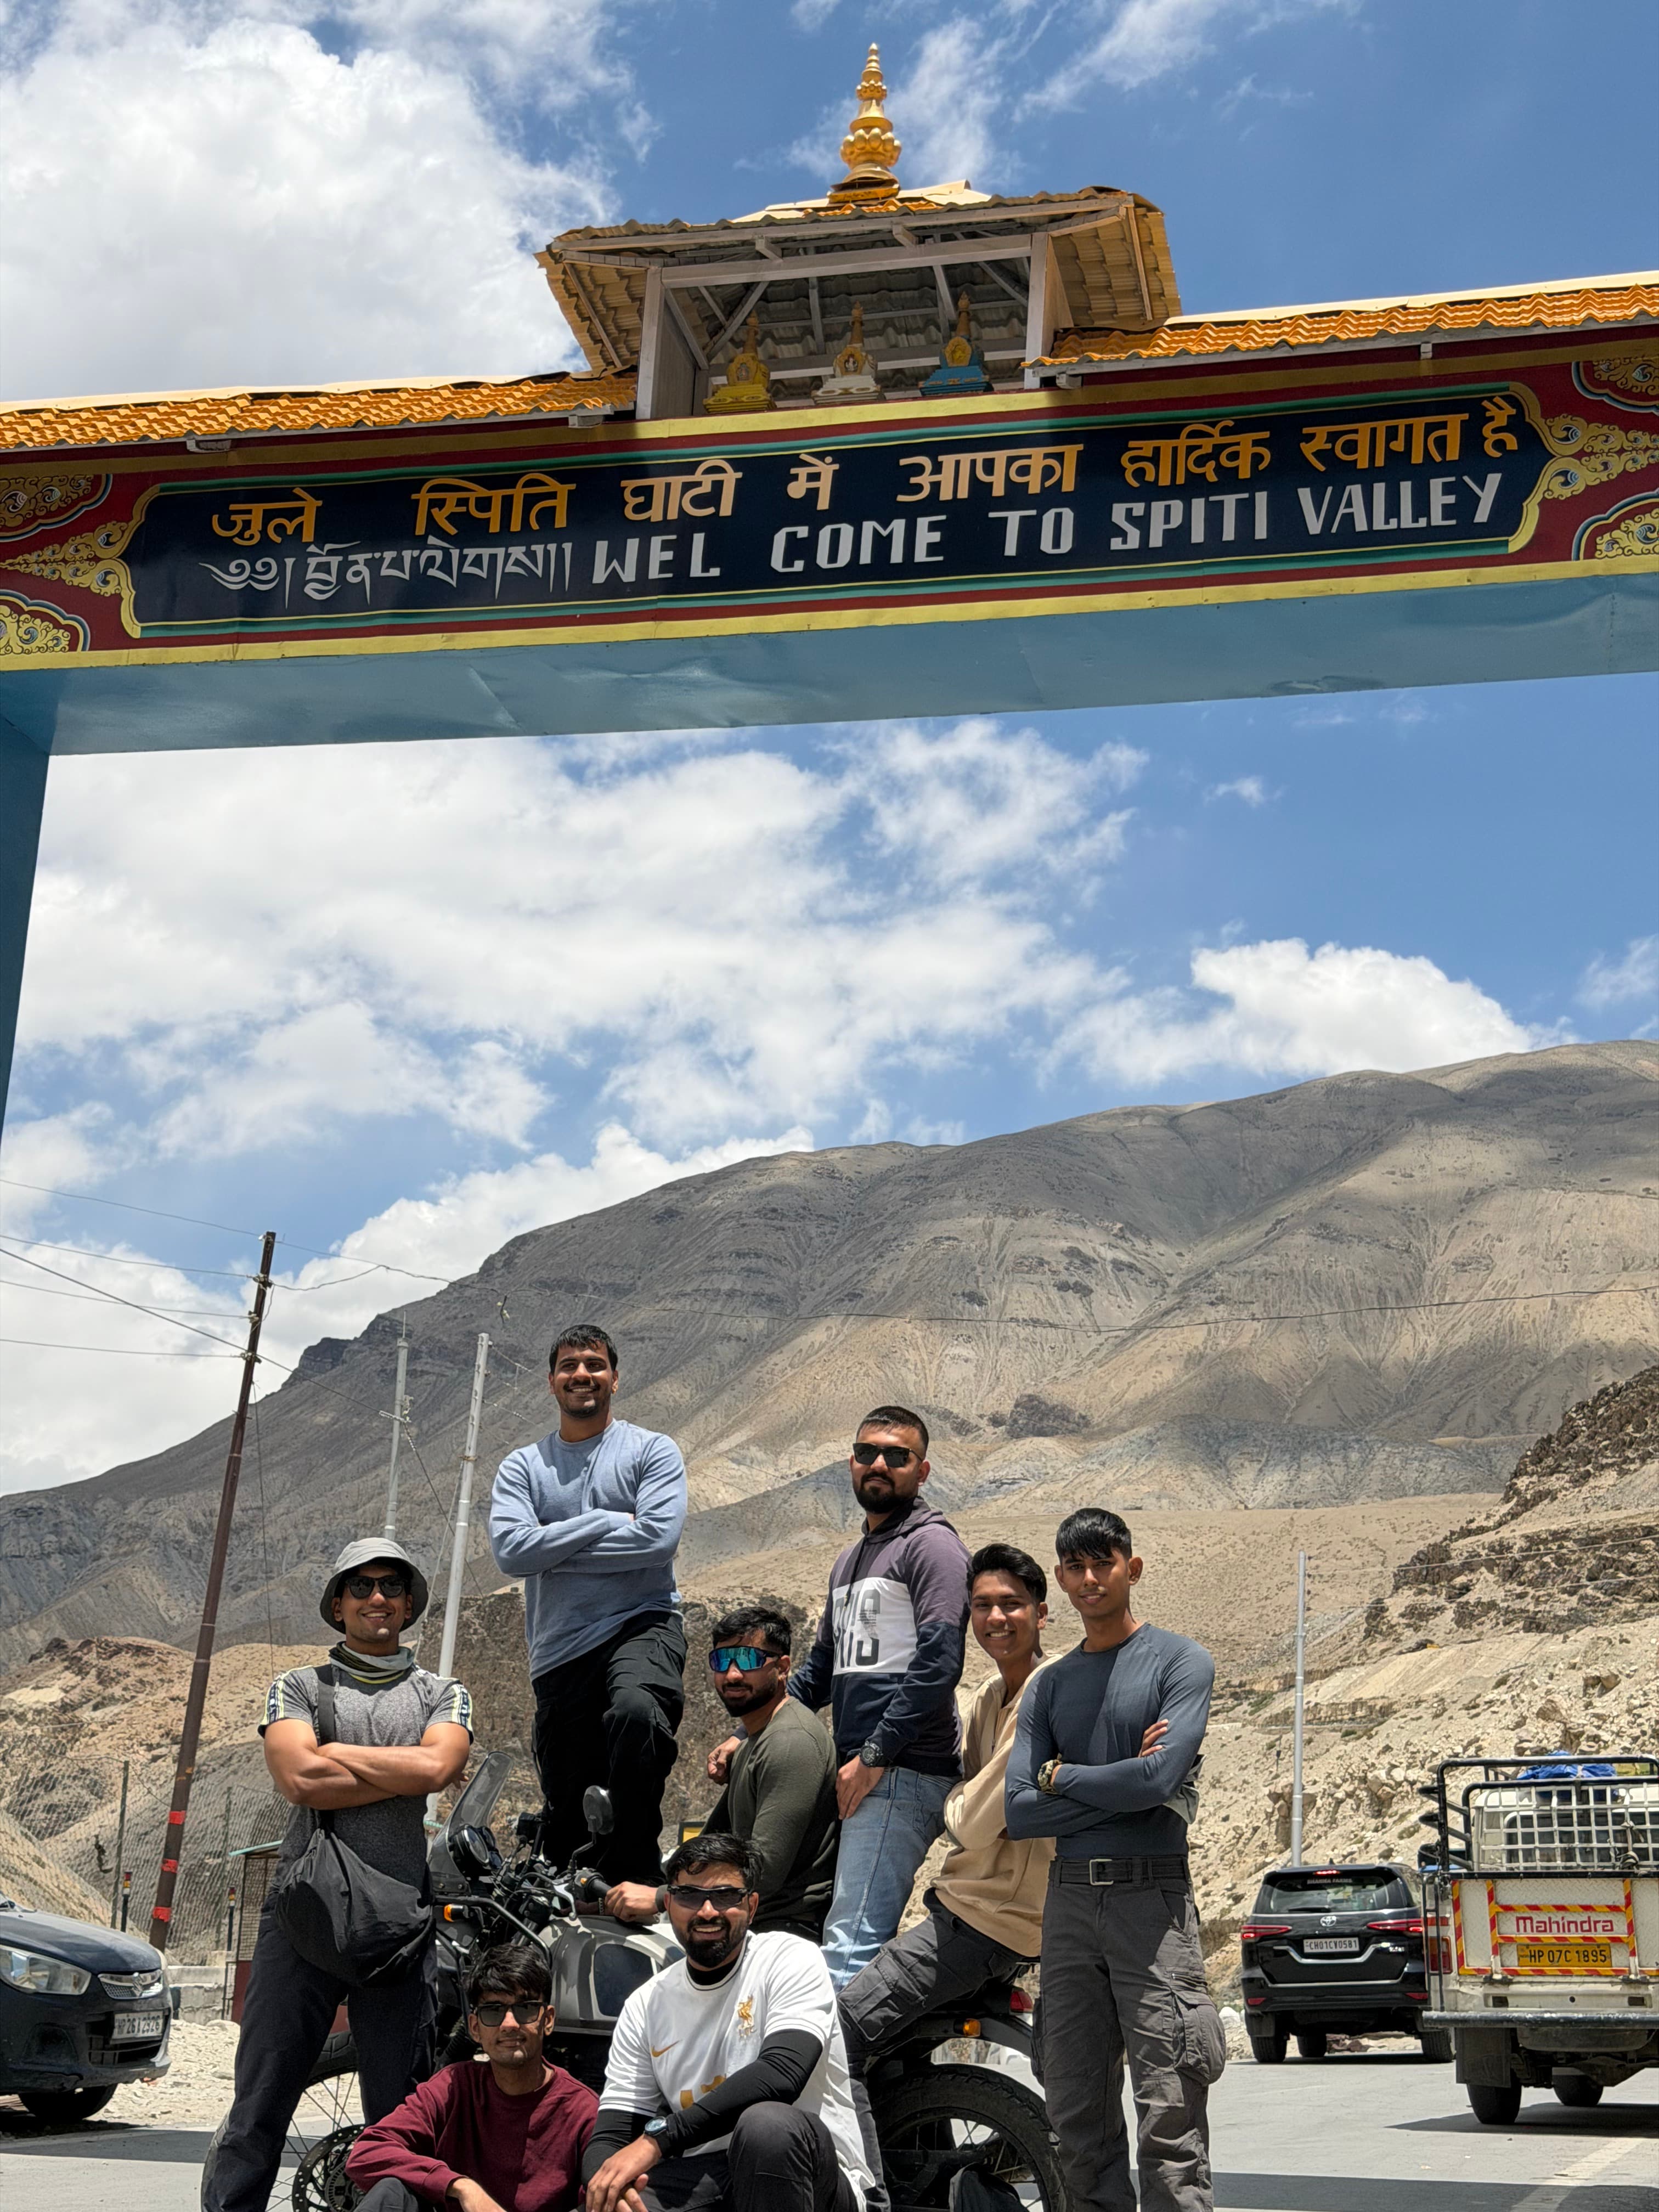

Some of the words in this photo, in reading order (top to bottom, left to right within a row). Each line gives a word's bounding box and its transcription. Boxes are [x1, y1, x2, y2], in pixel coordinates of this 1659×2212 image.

[212, 487, 323, 546] जुले
[411, 472, 577, 535] स्पिति
[620, 459, 742, 522] घाटी
[787, 453, 839, 510] में
[896, 443, 1084, 501] आपका
[1121, 420, 1271, 487] हार्दिक
[1300, 413, 1469, 472] स्वागत
[1481, 396, 1519, 458] है
[592, 532, 720, 584] WEL
[770, 515, 947, 573] COME
[989, 507, 1074, 556] TO
[1110, 491, 1267, 550] SPITI
[1297, 472, 1502, 535] VALLEY
[1516, 1916, 1614, 1933] Mahindra
[1529, 1950, 1544, 1962] HP
[1575, 1949, 1607, 1962] 1895
